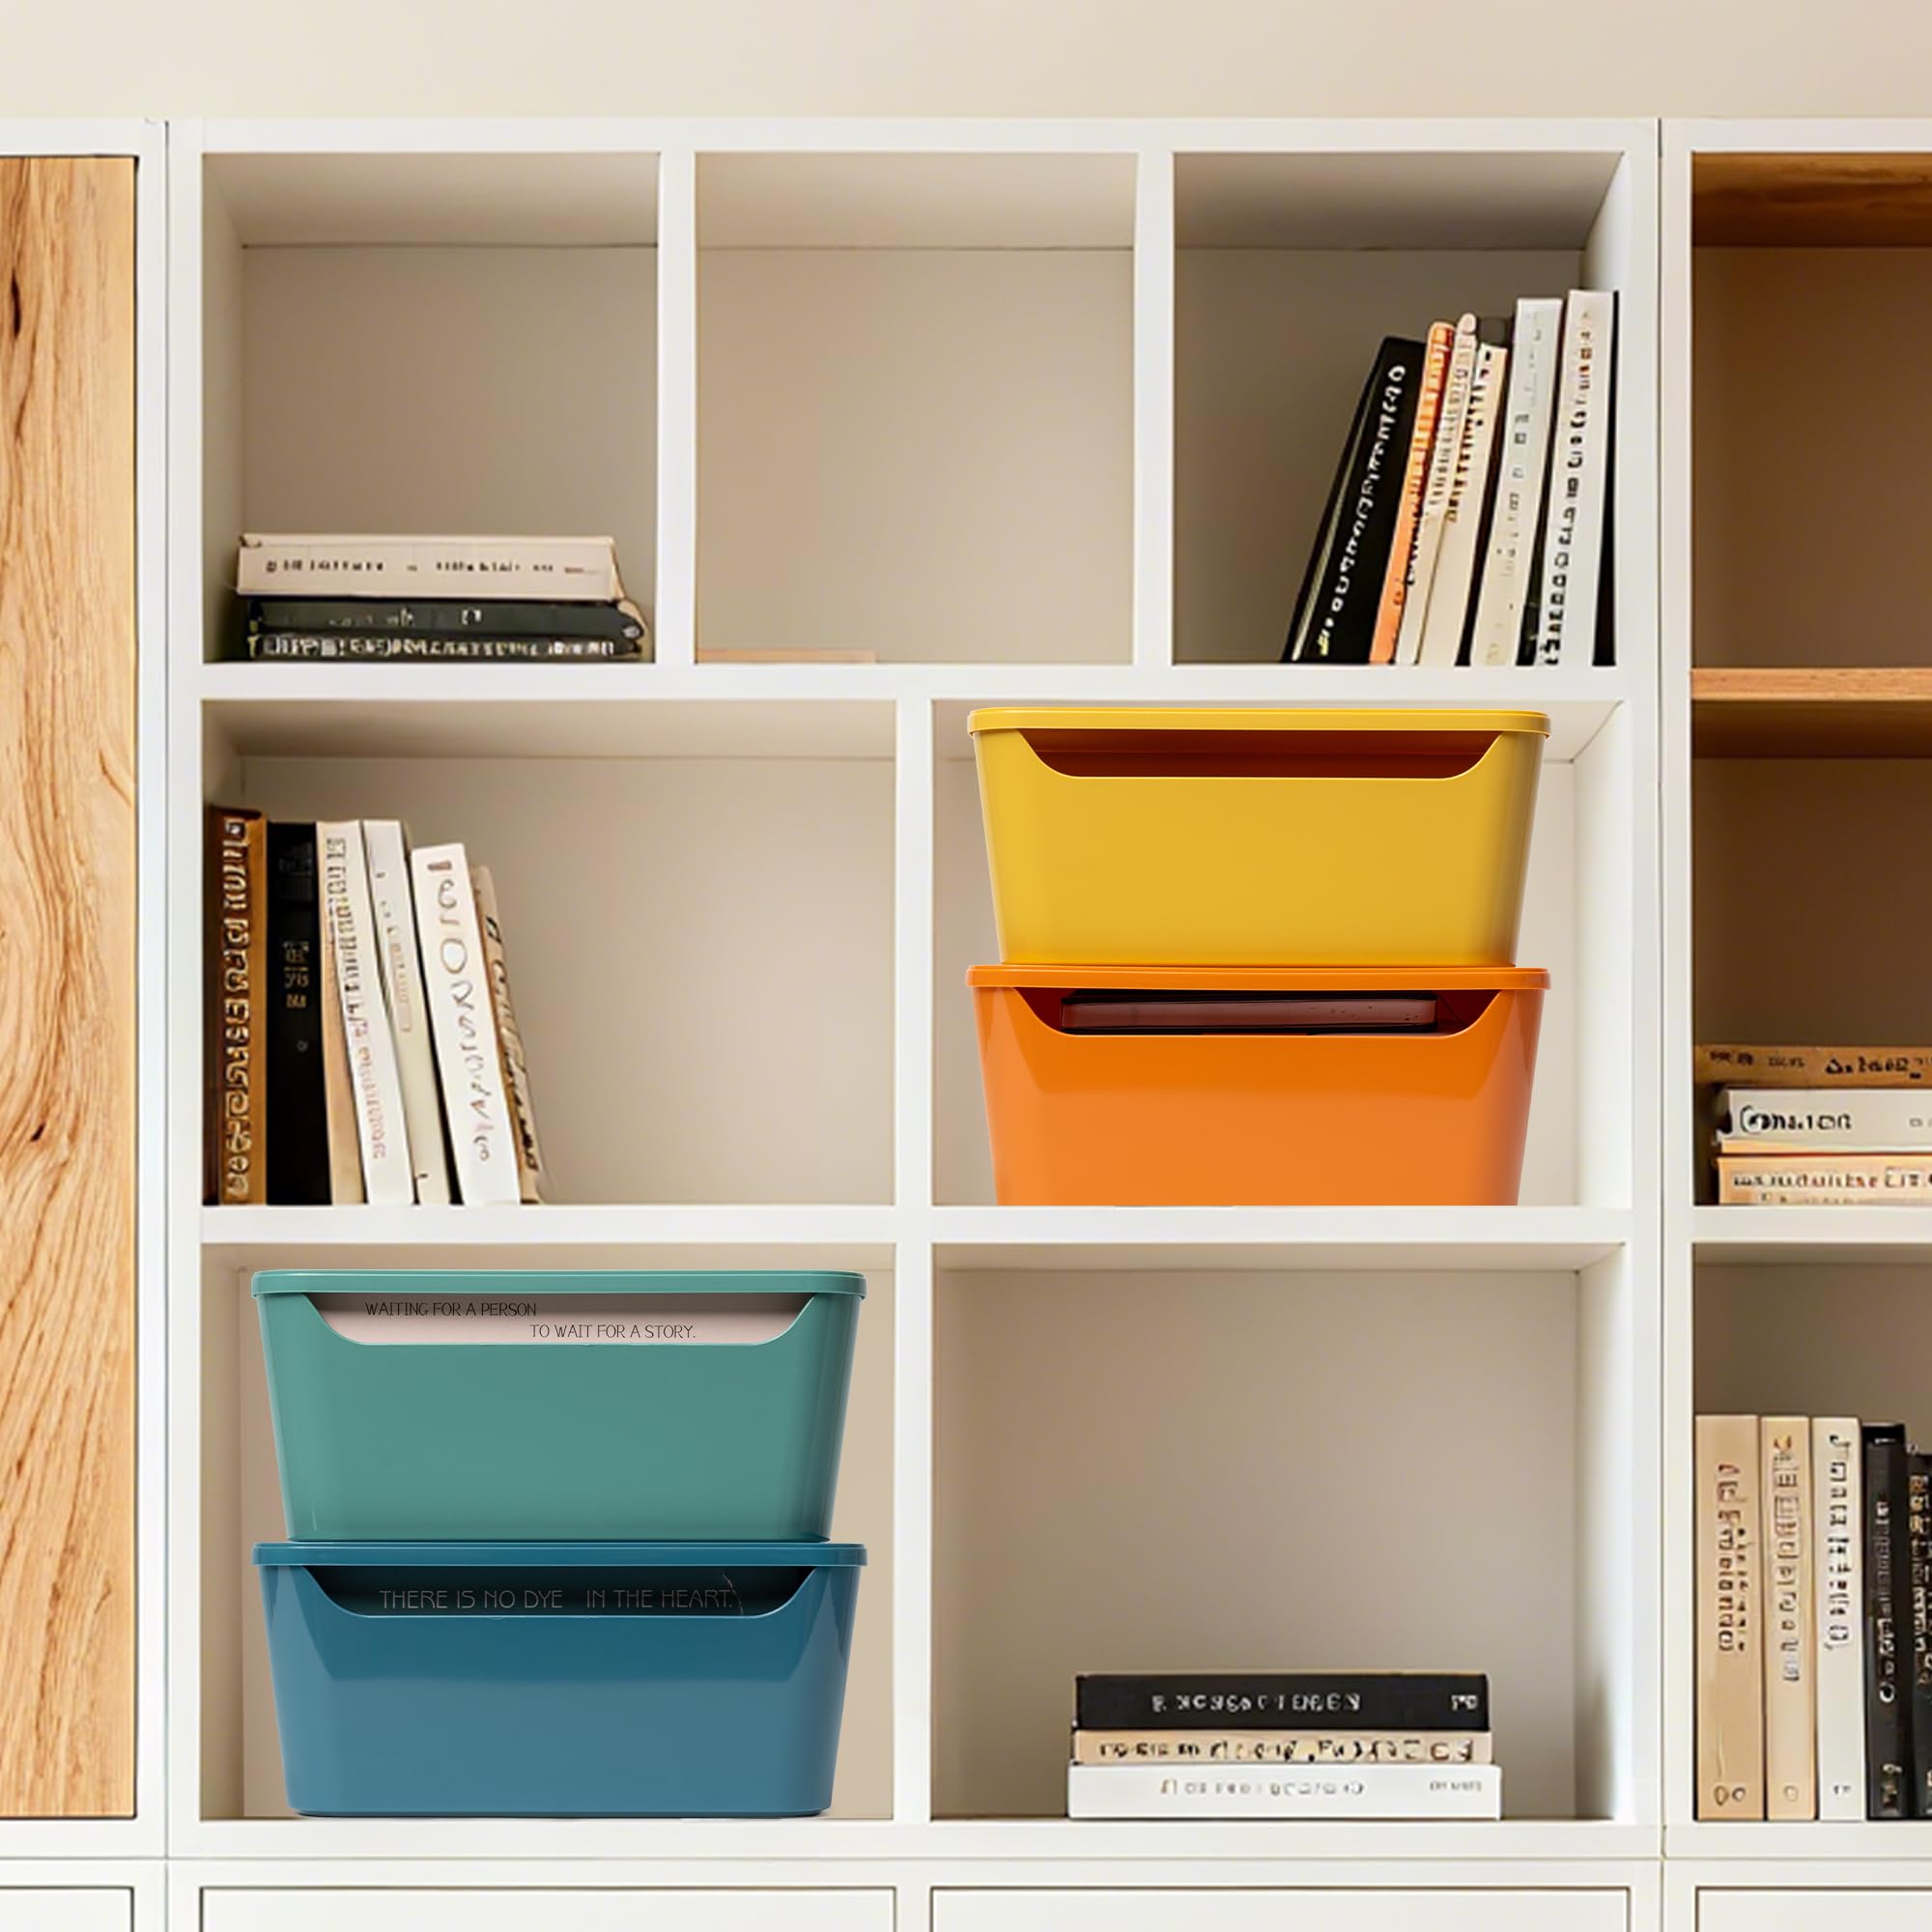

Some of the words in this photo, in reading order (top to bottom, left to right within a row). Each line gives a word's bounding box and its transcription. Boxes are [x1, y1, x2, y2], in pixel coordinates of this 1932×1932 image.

[365, 1302, 429, 1317] WAITING
[434, 1302, 462, 1317] FOR
[466, 1302, 477, 1317] A
[481, 1302, 537, 1317] PERSON
[529, 1324, 551, 1339] TO
[554, 1324, 593, 1339] WAIT
[597, 1324, 626, 1339] FOR
[630, 1324, 641, 1339] A
[644, 1324, 696, 1339] STORY.
[380, 1590, 448, 1609] THERE
[457, 1590, 476, 1609] IS
[484, 1590, 516, 1609] NO
[524, 1590, 563, 1608] DYE
[586, 1589, 606, 1608] IN
[613, 1589, 653, 1608] THE
[662, 1589, 733, 1608] HEART.
